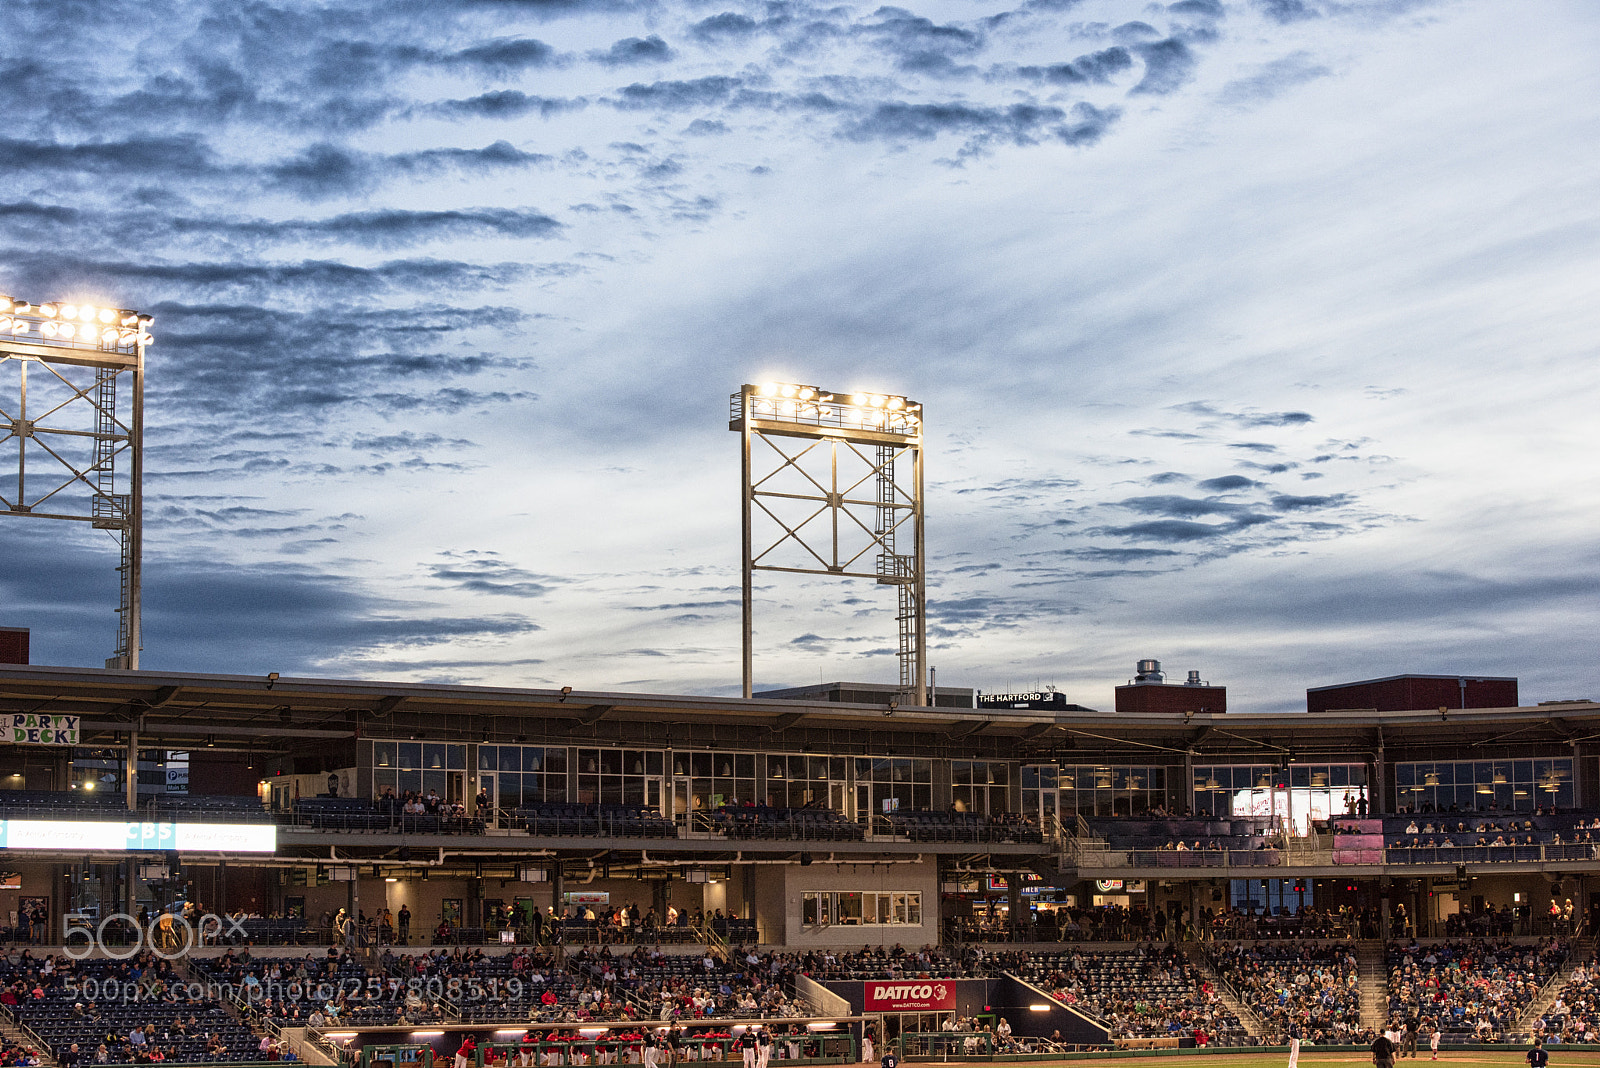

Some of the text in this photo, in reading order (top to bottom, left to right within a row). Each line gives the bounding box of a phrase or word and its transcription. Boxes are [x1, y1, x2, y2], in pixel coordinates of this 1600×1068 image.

[997, 694, 1041, 702] HARTFORD
[13, 714, 79, 730] PARTY
[13, 728, 77, 744] DECK!
[125, 822, 172, 840] CBS
[873, 985, 933, 1000] DATTCO
